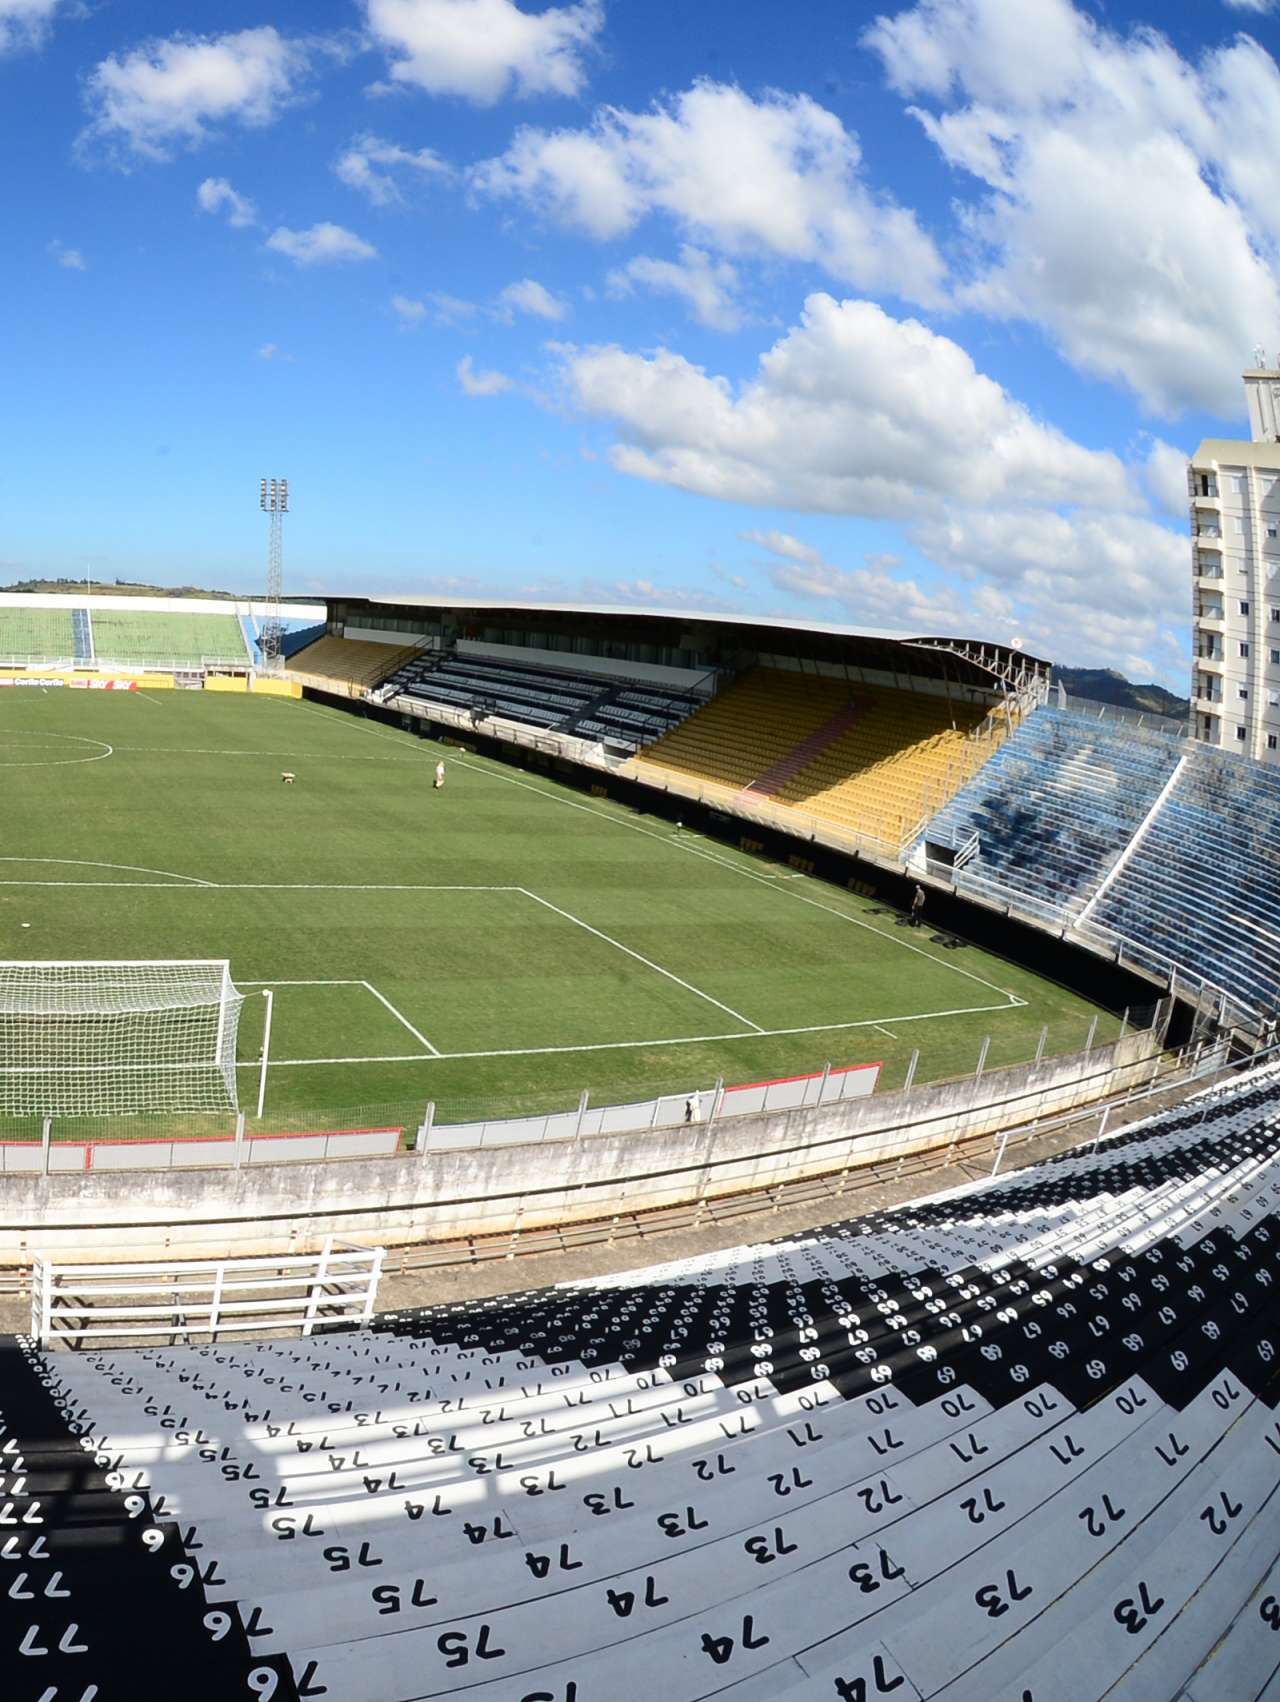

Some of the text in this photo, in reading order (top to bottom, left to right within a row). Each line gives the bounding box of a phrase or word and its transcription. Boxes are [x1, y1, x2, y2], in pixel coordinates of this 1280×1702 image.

[1089, 1316, 1109, 1336] 67
[1159, 1307, 1176, 1324] 67
[1123, 1334, 1143, 1351] 68
[1202, 1321, 1220, 1339] 68
[981, 1345, 1002, 1360] 68
[1048, 1341, 1069, 1358] 68
[1255, 1339, 1276, 1362] 69
[871, 1365, 891, 1381] 69
[938, 1367, 955, 1383] 69
[1010, 1365, 1029, 1382] 69
[1086, 1360, 1105, 1378] 69
[797, 1390, 829, 1411] 70
[941, 1394, 975, 1417] 70
[1024, 1394, 1057, 1417] 70
[1212, 1381, 1239, 1409] 70
[483, 1409, 514, 1425] 72
[521, 1419, 558, 1439] 72
[298, 1438, 335, 1453] 74
[429, 1436, 463, 1453] 73
[572, 1431, 611, 1451] 72
[787, 1423, 822, 1446] 71
[868, 1429, 903, 1454] 71
[199, 1446, 236, 1462] 75
[625, 1446, 665, 1471] 72
[950, 1434, 988, 1462] 71
[1155, 1434, 1189, 1466] 71
[222, 1464, 259, 1481] 75
[325, 1451, 372, 1473] 74
[692, 1455, 735, 1480] 72
[105, 1472, 150, 1490] 76
[768, 1468, 812, 1495] 72
[406, 1498, 451, 1520] 74
[584, 1487, 634, 1515] 73
[858, 1481, 902, 1513] 72
[960, 1489, 1005, 1523] 72
[658, 1507, 708, 1537] 73
[1079, 1495, 1125, 1536] 72
[1200, 1492, 1242, 1534] 72
[142, 1528, 203, 1552] 76
[273, 1519, 324, 1540] 75
[464, 1517, 513, 1544] 74
[2, 1537, 48, 1558] 77
[324, 1543, 382, 1571] 75
[745, 1528, 797, 1564] 73
[526, 1544, 582, 1578] 74
[849, 1550, 905, 1593] 73
[9, 1572, 70, 1599] 77
[170, 1561, 226, 1589] 76
[372, 1579, 437, 1614] 75
[606, 1576, 669, 1618] 74
[976, 1570, 1032, 1617] 73
[1114, 1582, 1164, 1633] 73
[203, 1608, 274, 1641] 76
[19, 1624, 88, 1655] 77
[438, 1625, 505, 1667] 75
[701, 1615, 769, 1663] 74
[835, 1656, 904, 1702] 74
